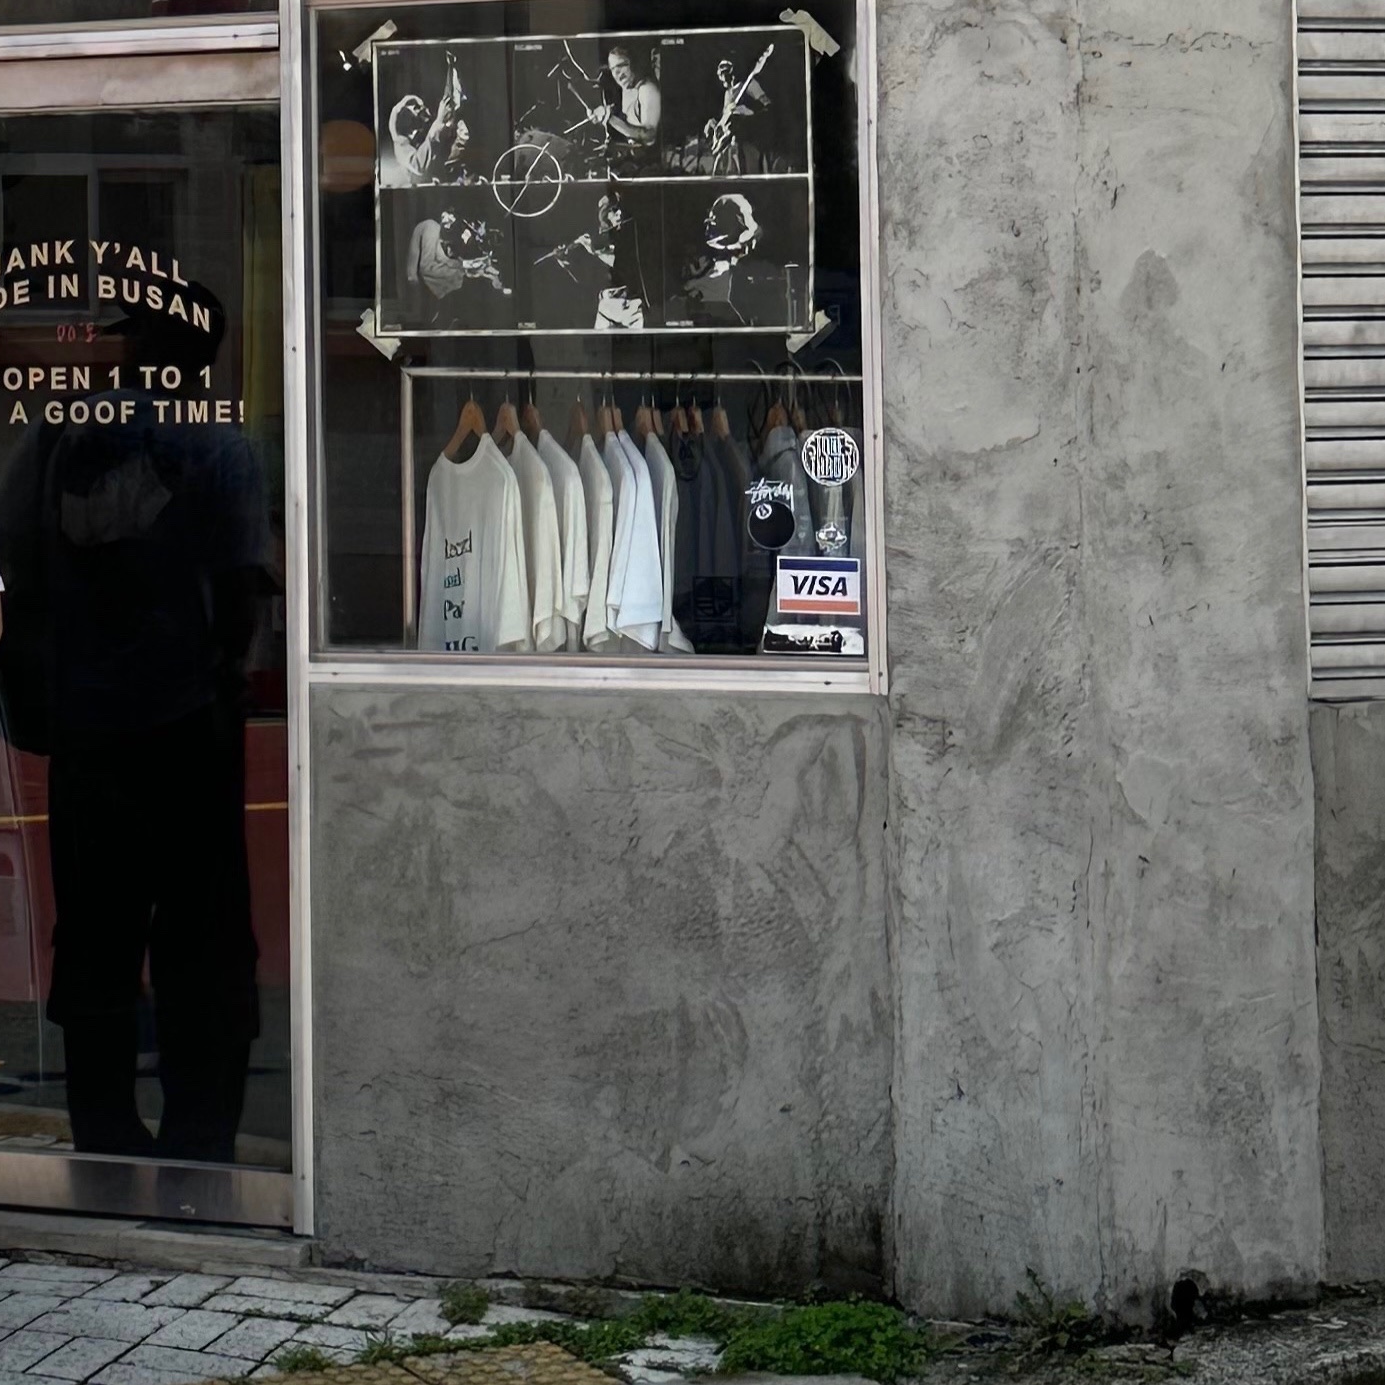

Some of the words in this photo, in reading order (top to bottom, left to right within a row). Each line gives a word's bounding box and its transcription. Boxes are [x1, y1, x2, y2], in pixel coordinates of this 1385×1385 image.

[90, 241, 189, 288] Y'ALL
[48, 274, 79, 299] IN
[98, 275, 211, 333] BUSAN
[3, 367, 90, 390] OPEN
[108, 366, 120, 389] 1
[139, 366, 181, 389] TO
[199, 365, 211, 389] 1
[10, 401, 28, 424] A
[45, 401, 136, 424] GOOF
[152, 400, 244, 424] TIME!
[791, 575, 848, 597] VISA
